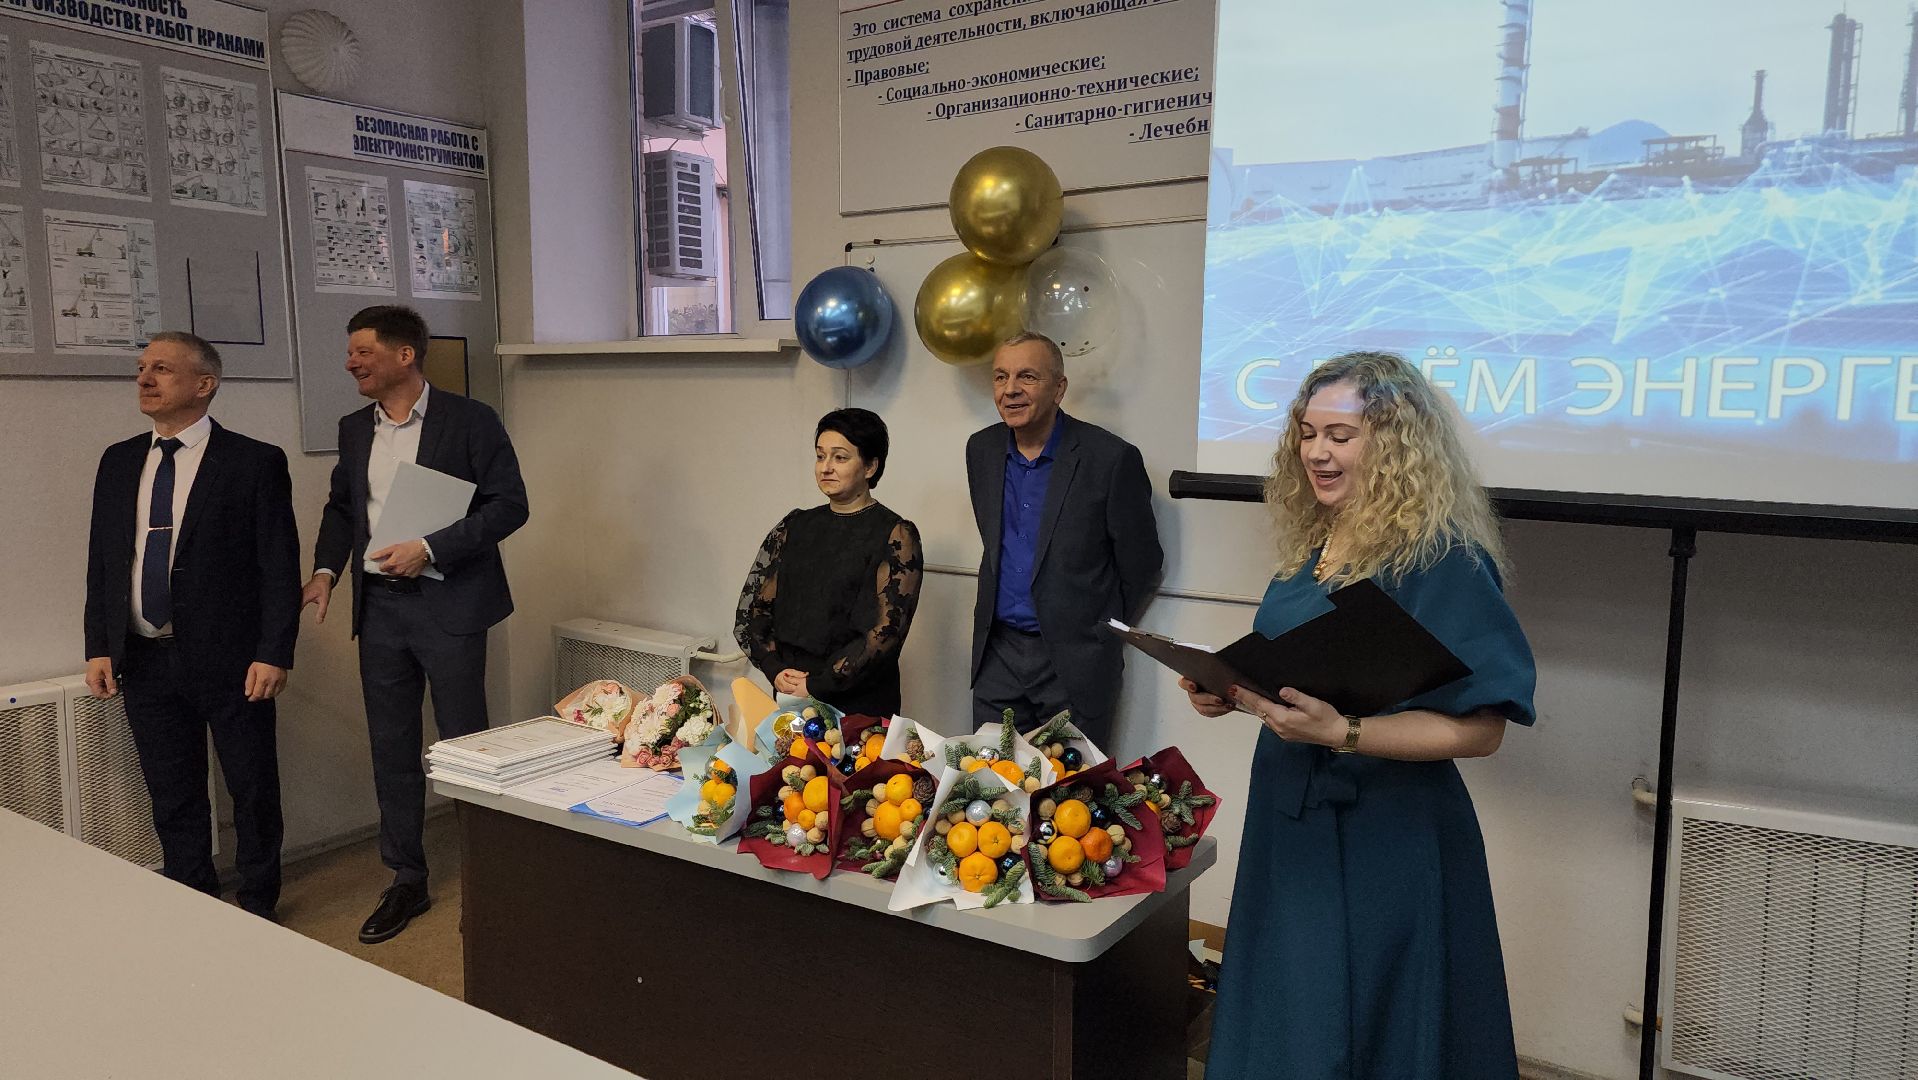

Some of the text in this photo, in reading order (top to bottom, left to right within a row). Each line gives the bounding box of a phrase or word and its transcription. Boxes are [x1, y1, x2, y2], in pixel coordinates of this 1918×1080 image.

[145, 15, 193, 43] РАБОТ
[197, 27, 264, 58] КРАНАМИ
[847, 35, 912, 63] трудовой
[915, 16, 1027, 50] деятельности,
[853, 22, 877, 37] Это
[883, 9, 941, 31] система
[854, 61, 930, 86] Правовые;
[886, 55, 1105, 102] Социально-экономические;
[935, 66, 1199, 120] Организационно-технические;
[353, 134, 485, 170] ЭЛЕКТРОИНСТРУМЕНТОМ
[355, 114, 479, 151] БЕЗОПАСНАЯ РАБОТА С
[1235, 357, 1280, 410] С
